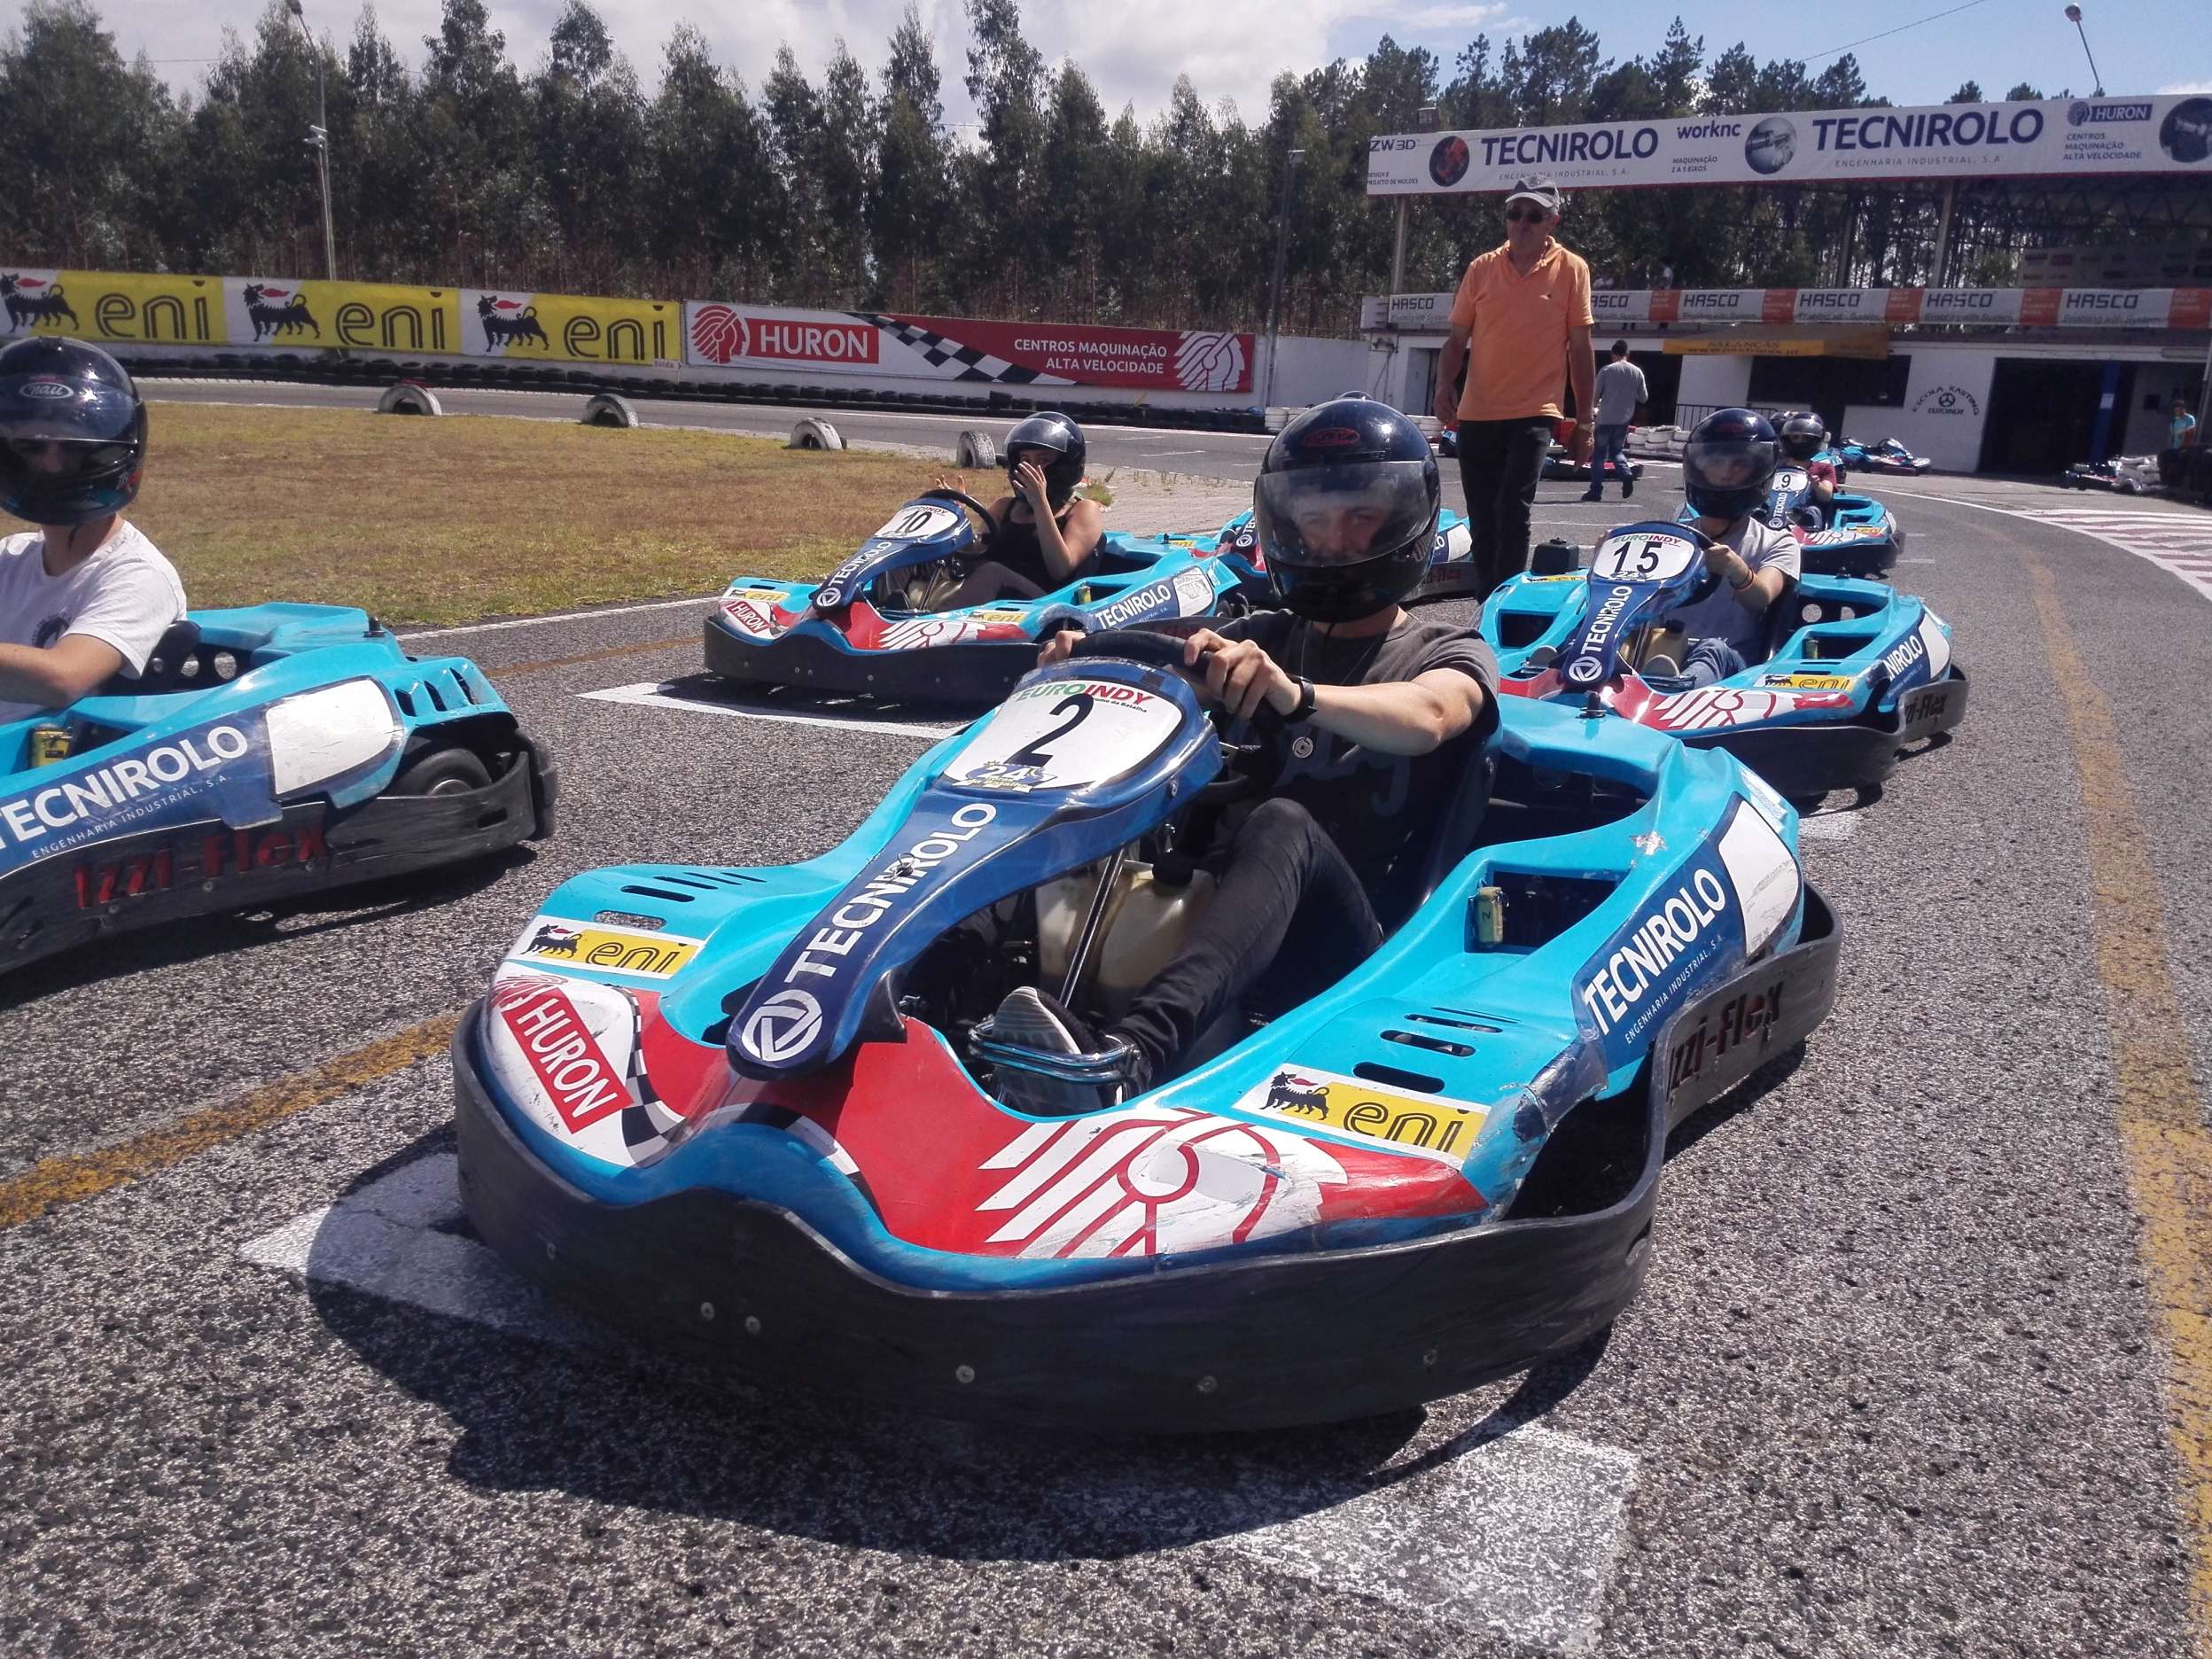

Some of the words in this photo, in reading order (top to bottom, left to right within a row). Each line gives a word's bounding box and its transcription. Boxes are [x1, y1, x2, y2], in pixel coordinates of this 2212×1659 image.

[2095, 106, 2147, 121] HURON
[1812, 108, 2045, 152] TECNIROLO
[2067, 132, 2106, 141] CENTROS
[1481, 128, 1659, 167] TECNIROLO
[2065, 141, 2124, 151] MAQUINAÇÃO
[1835, 158, 1903, 167] ENGENHARIA
[96, 280, 209, 341] eni
[1392, 297, 1435, 310] HASCO
[1593, 295, 1629, 308] ASCO
[1683, 293, 1740, 308] HASCO
[1799, 293, 1861, 308] HASCO
[1926, 293, 1994, 308] HASCO
[2065, 292, 2139, 309] HASCO
[335, 291, 446, 351] eni
[563, 304, 666, 361] eni
[759, 324, 868, 359] HURON
[1014, 338, 1075, 354] CENTROS
[1078, 340, 1167, 359] MAQUINAÇÃO
[1046, 356, 1079, 370] ALTA
[1081, 358, 1164, 374] VELOCIDADE
[1780, 474, 1791, 488] 9
[895, 510, 932, 534] 10
[1613, 534, 1682, 544] EUROINDY
[1613, 541, 1663, 573] 15
[732, 601, 769, 632] HURON
[1094, 584, 1172, 629] TECNIROLO
[1882, 635, 1923, 682] NIROLO
[1018, 683, 1155, 705] EUROINDY
[1003, 692, 1094, 768] 2
[0, 726, 248, 848] ECNIROLO
[976, 766, 1031, 780] 24
[32, 819, 116, 859] ENGENHARIA
[784, 803, 998, 984] TECNIROLO
[586, 940, 688, 975] eni
[1583, 868, 1726, 1035] TECNIROLO
[1624, 992, 1669, 1044] ENGENHARIA
[517, 996, 617, 1120] HURON
[1344, 1101, 1471, 1154] eni
